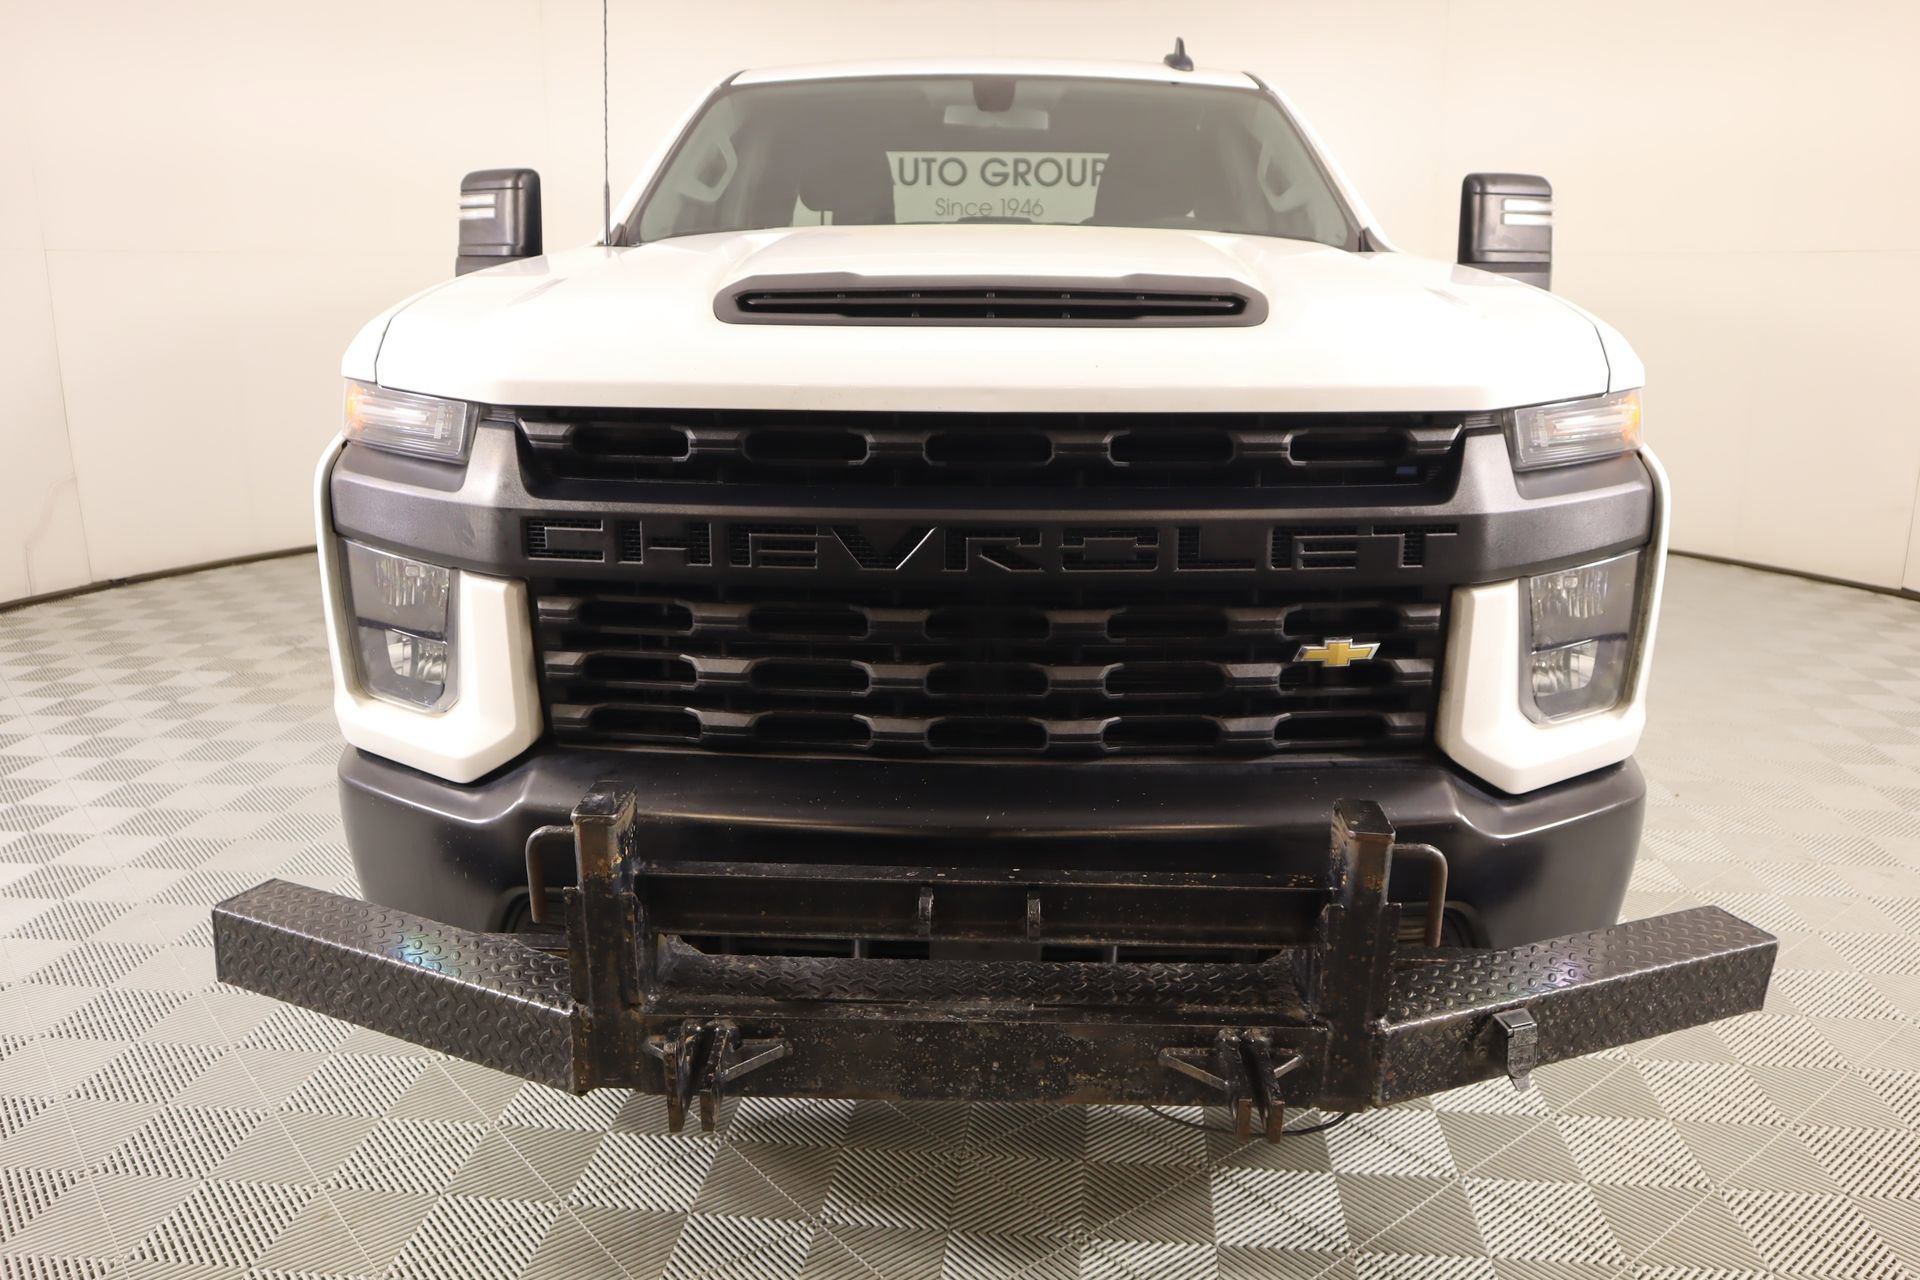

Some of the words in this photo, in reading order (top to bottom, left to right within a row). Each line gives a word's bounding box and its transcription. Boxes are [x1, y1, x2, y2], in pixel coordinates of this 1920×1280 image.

[893, 157, 968, 186] UTO
[935, 197, 993, 217] Since
[1000, 198, 1044, 217] 1946
[526, 517, 1458, 572] CHEVROLET
